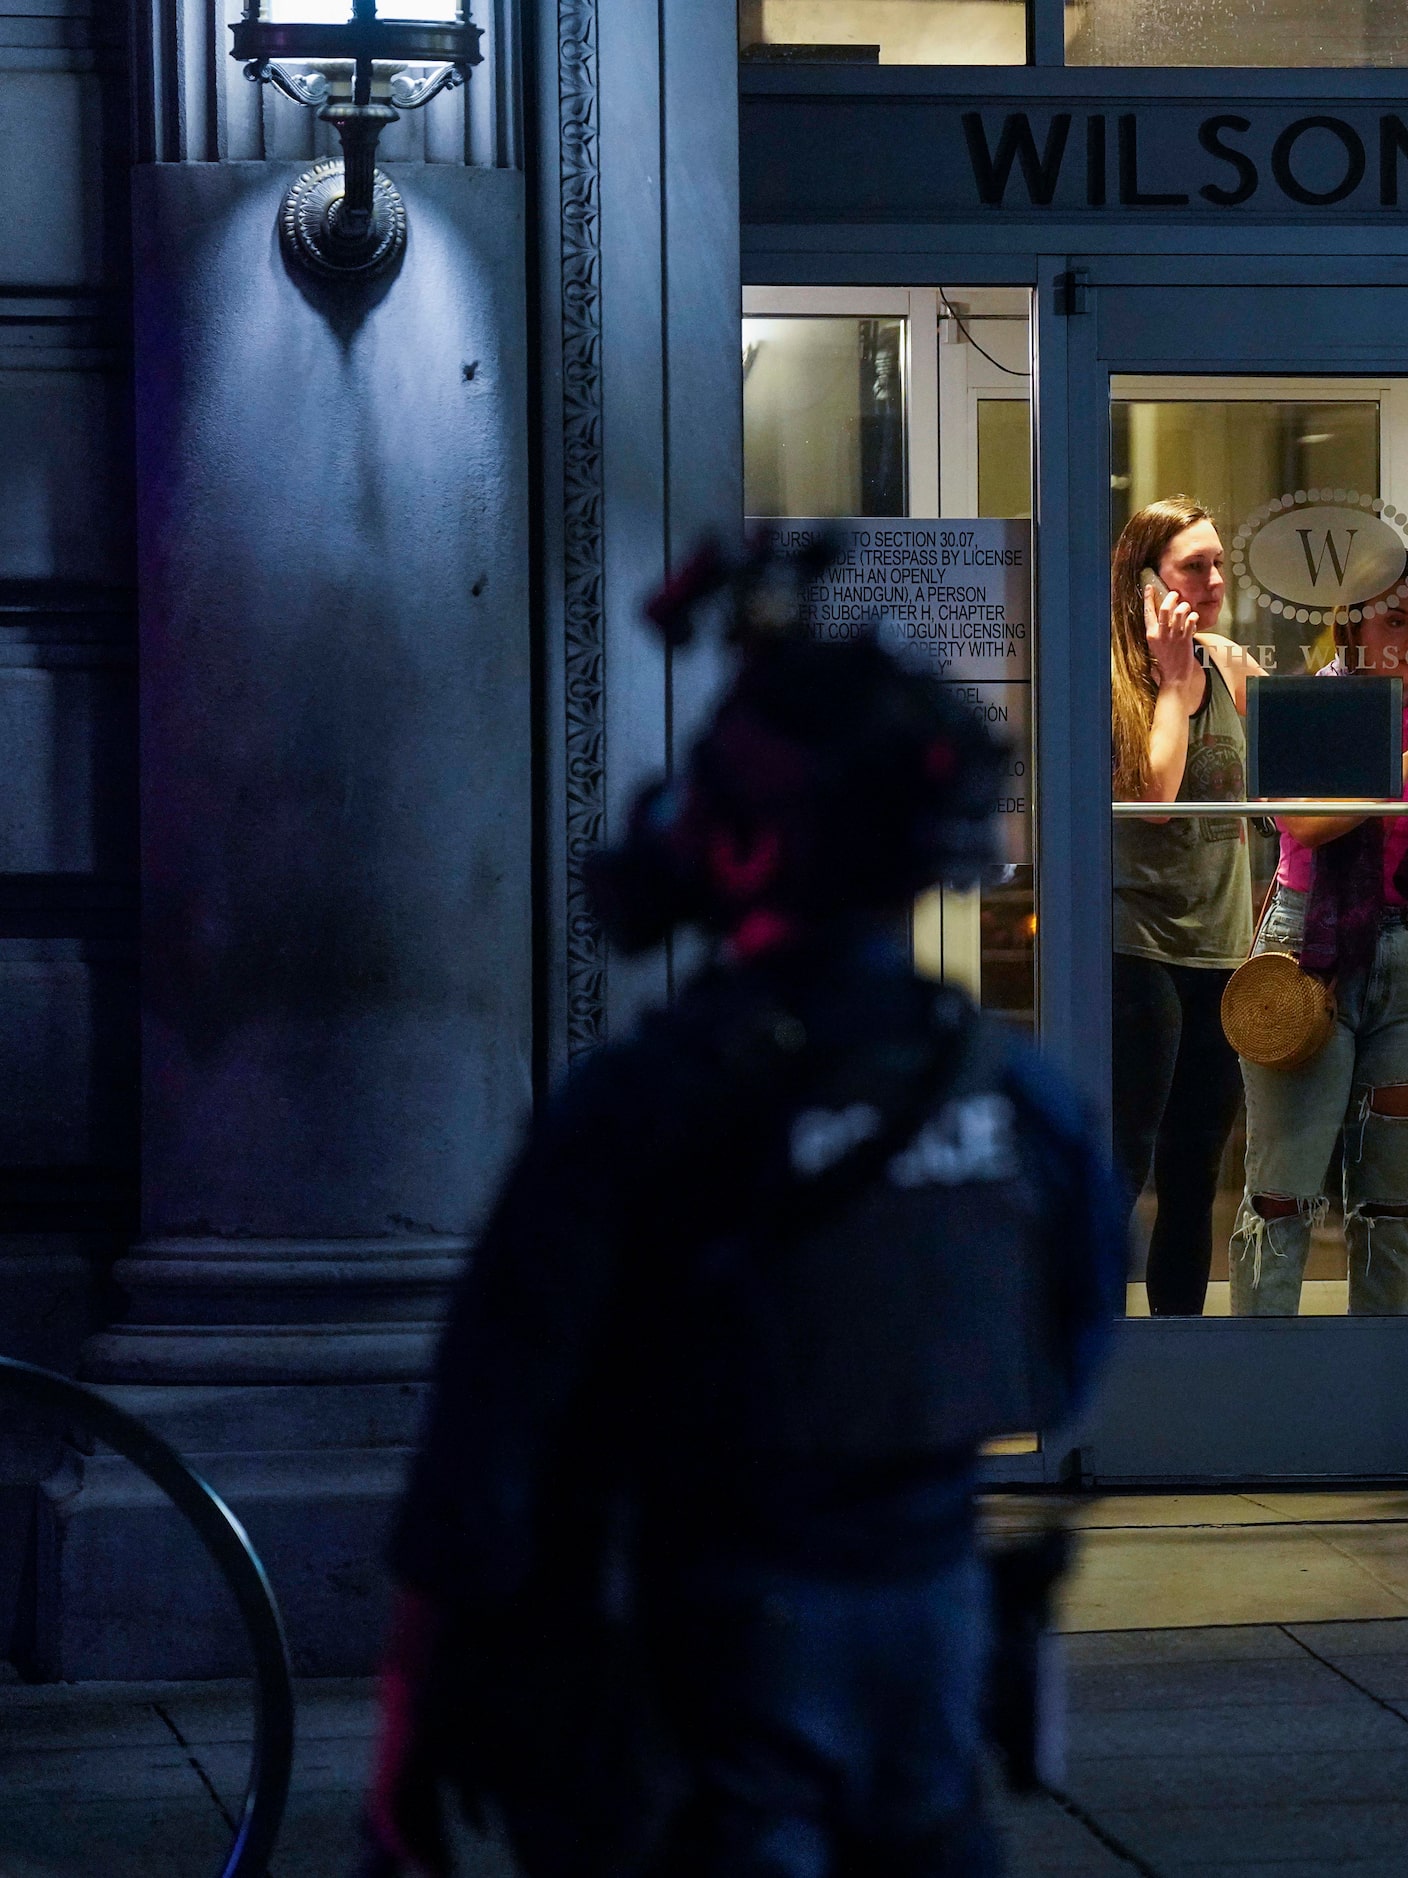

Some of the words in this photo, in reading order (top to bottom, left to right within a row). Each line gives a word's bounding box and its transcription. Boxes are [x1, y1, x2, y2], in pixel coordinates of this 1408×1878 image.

[771, 532, 847, 548] PURSU
[853, 531, 871, 548] TO
[874, 531, 937, 548] SECTION
[940, 531, 978, 550] 30.07,
[859, 550, 939, 567] (TRESPASS
[941, 550, 959, 566] BY
[963, 550, 1023, 566] LICENSE
[1295, 529, 1359, 588] W
[828, 568, 864, 584] WITH
[866, 568, 888, 584] AN
[890, 568, 947, 584] OPENLY
[833, 587, 913, 605] HANDGUN),
[914, 587, 925, 602] A
[927, 587, 987, 603] PERSON
[821, 605, 918, 621] SUBCHAPTER
[920, 605, 935, 625] H,
[938, 605, 1006, 621] CHAPTER
[888, 623, 948, 639] ANDGUN
[951, 623, 1027, 640] LICENSING
[903, 642, 966, 658] ROPERTY
[968, 642, 1004, 658] WITH
[1006, 642, 1017, 658] A
[1194, 645, 1277, 670] THE
[956, 688, 984, 704] DEL
[992, 798, 1026, 813] EDE
